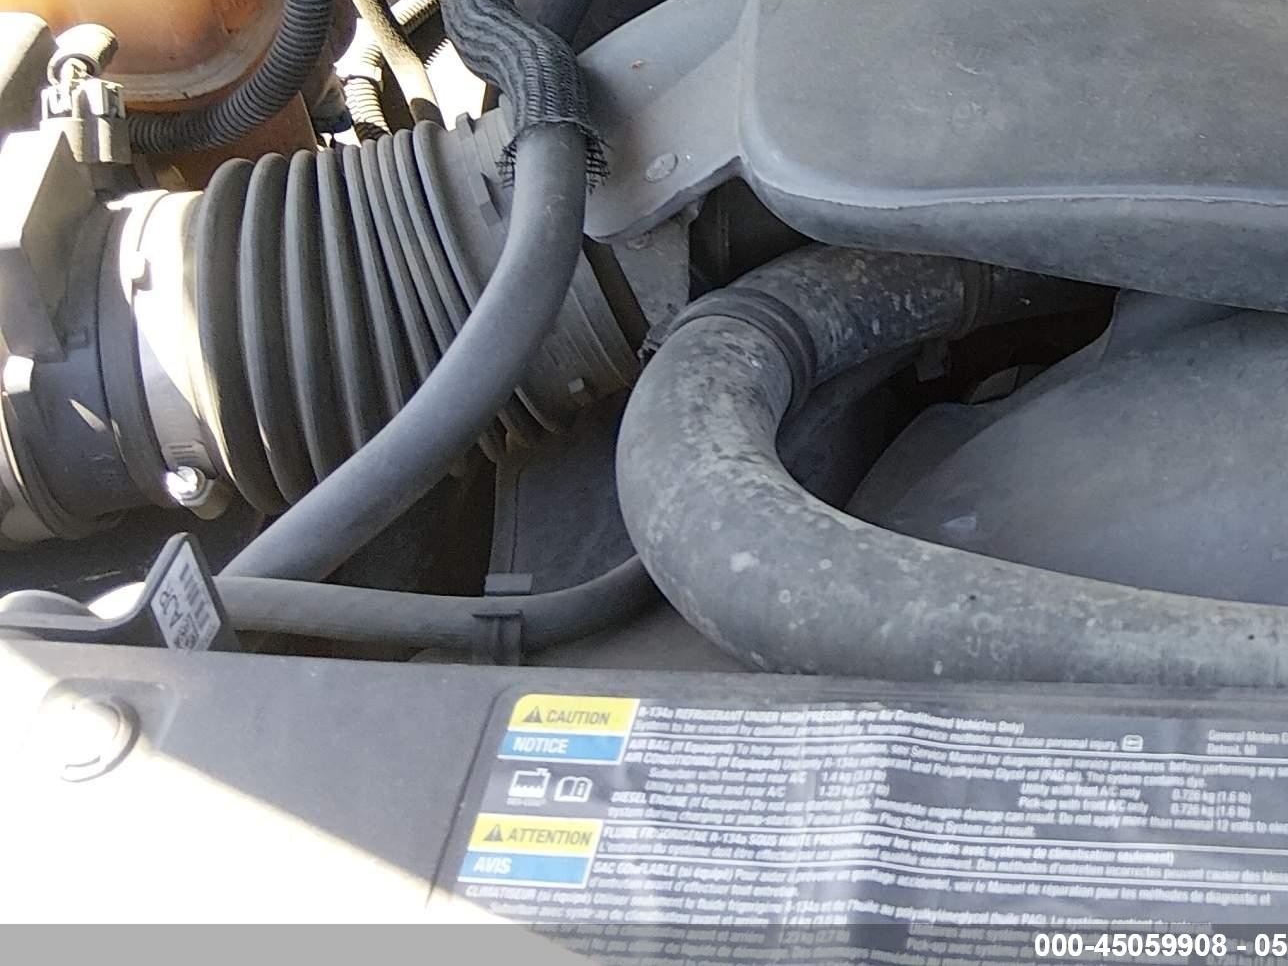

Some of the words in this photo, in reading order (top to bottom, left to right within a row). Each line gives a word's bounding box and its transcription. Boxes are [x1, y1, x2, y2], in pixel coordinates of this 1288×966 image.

[546, 709, 611, 725] CAUTION
[1208, 729, 1244, 742] General
[1246, 731, 1279, 743] Motors
[512, 738, 569, 754] NOTICE
[507, 828, 593, 846] ATTENTION
[473, 856, 513, 874] AVIS
